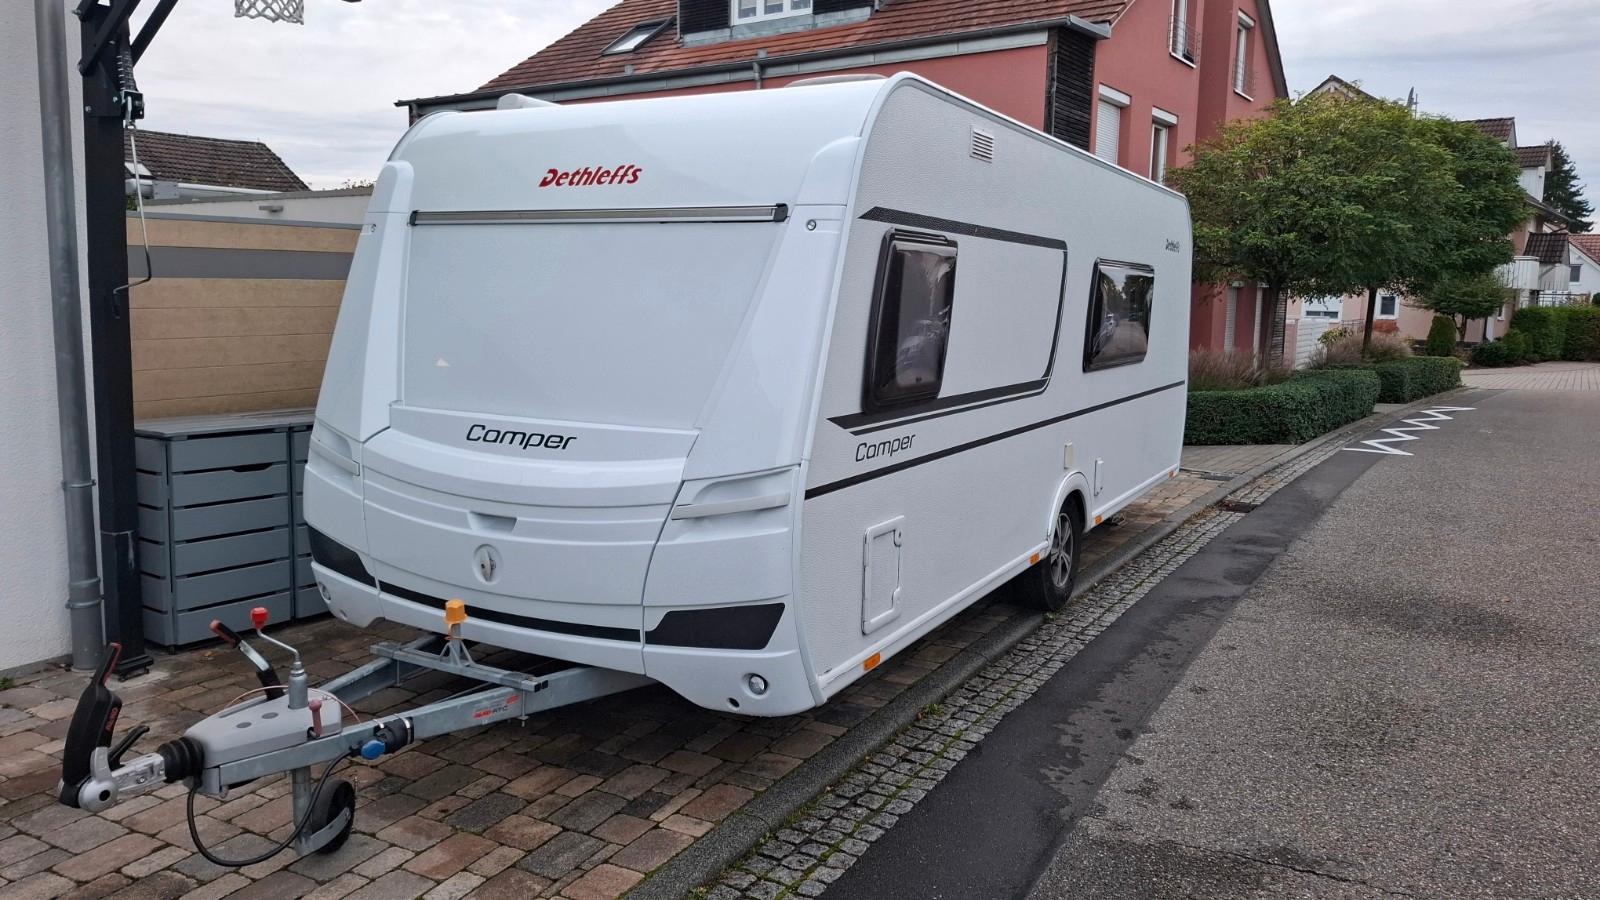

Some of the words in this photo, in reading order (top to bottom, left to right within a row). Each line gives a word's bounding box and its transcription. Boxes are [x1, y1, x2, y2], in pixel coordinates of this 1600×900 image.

[539, 164, 642, 187] Dethleffs
[466, 424, 577, 450] Camper
[855, 434, 916, 462] Camper
